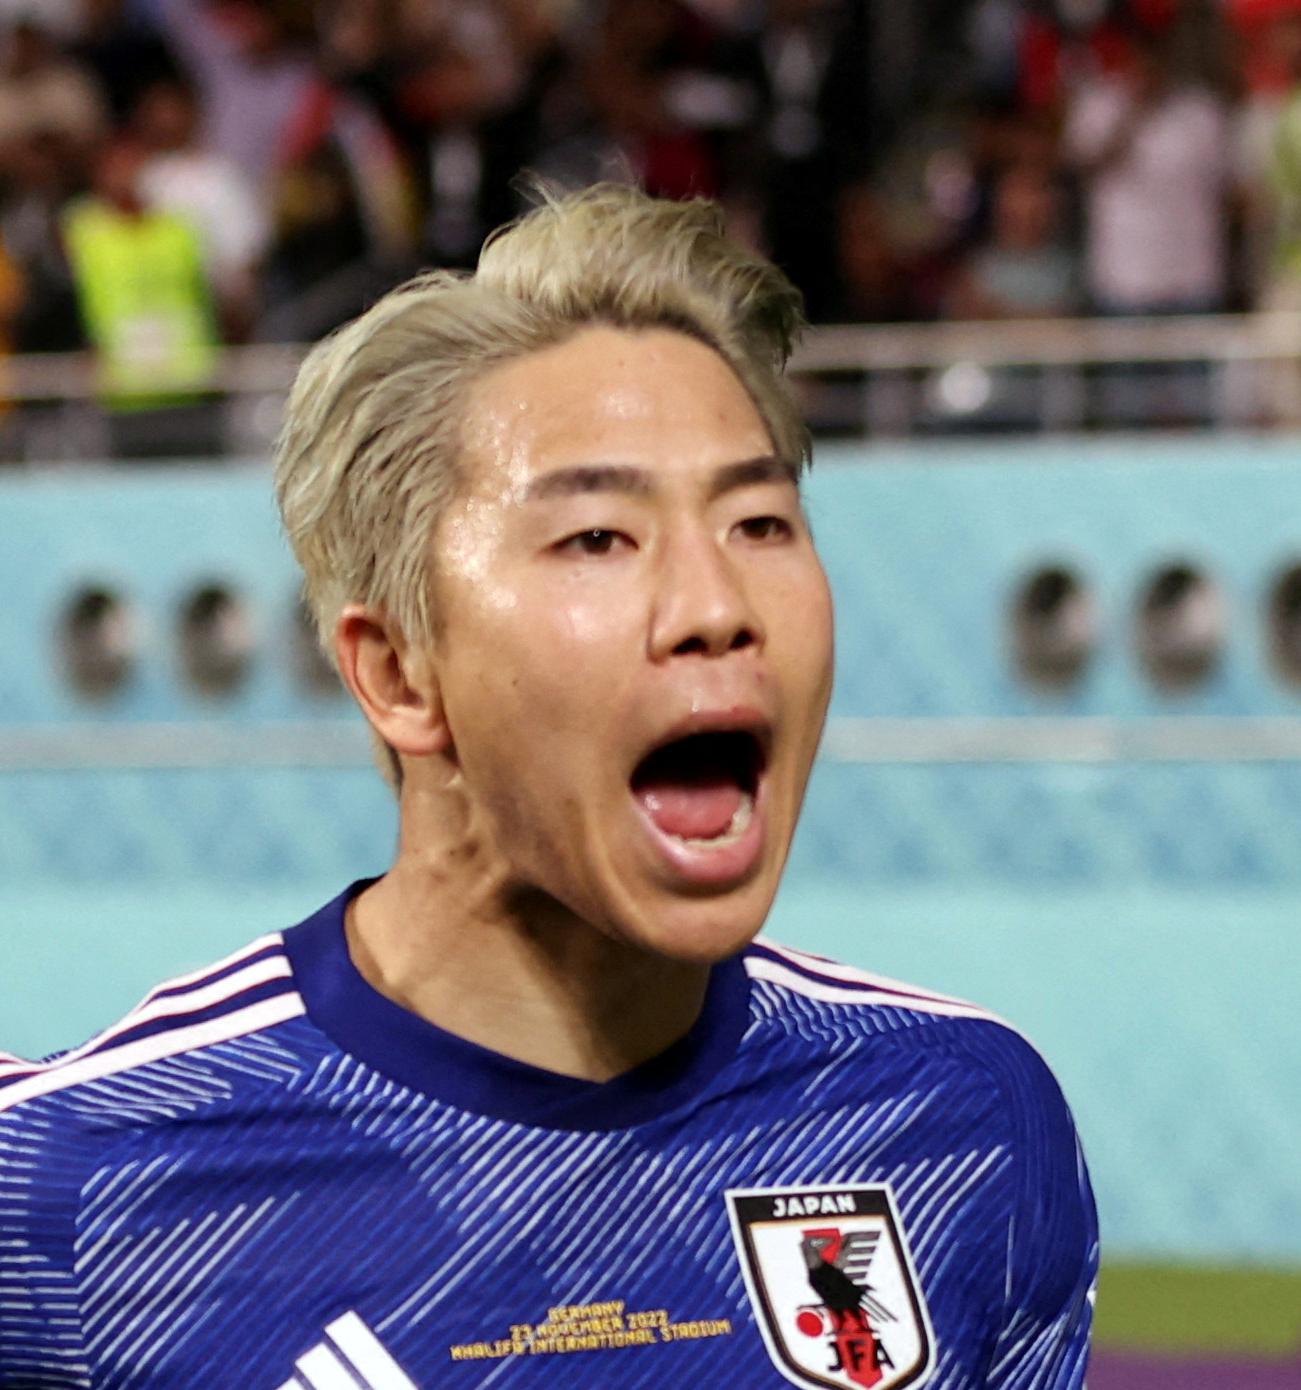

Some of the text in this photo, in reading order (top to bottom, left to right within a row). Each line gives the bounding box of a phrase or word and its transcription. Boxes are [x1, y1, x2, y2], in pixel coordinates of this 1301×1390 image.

[773, 1194, 856, 1217] JAPAN
[510, 1310, 668, 1342] 23 NOVEMBER 2022
[548, 1301, 625, 1322] GERMANY
[450, 1319, 731, 1360] KHALIFA INTERNATIONAL STADIUM
[827, 1339, 895, 1371] JFA
